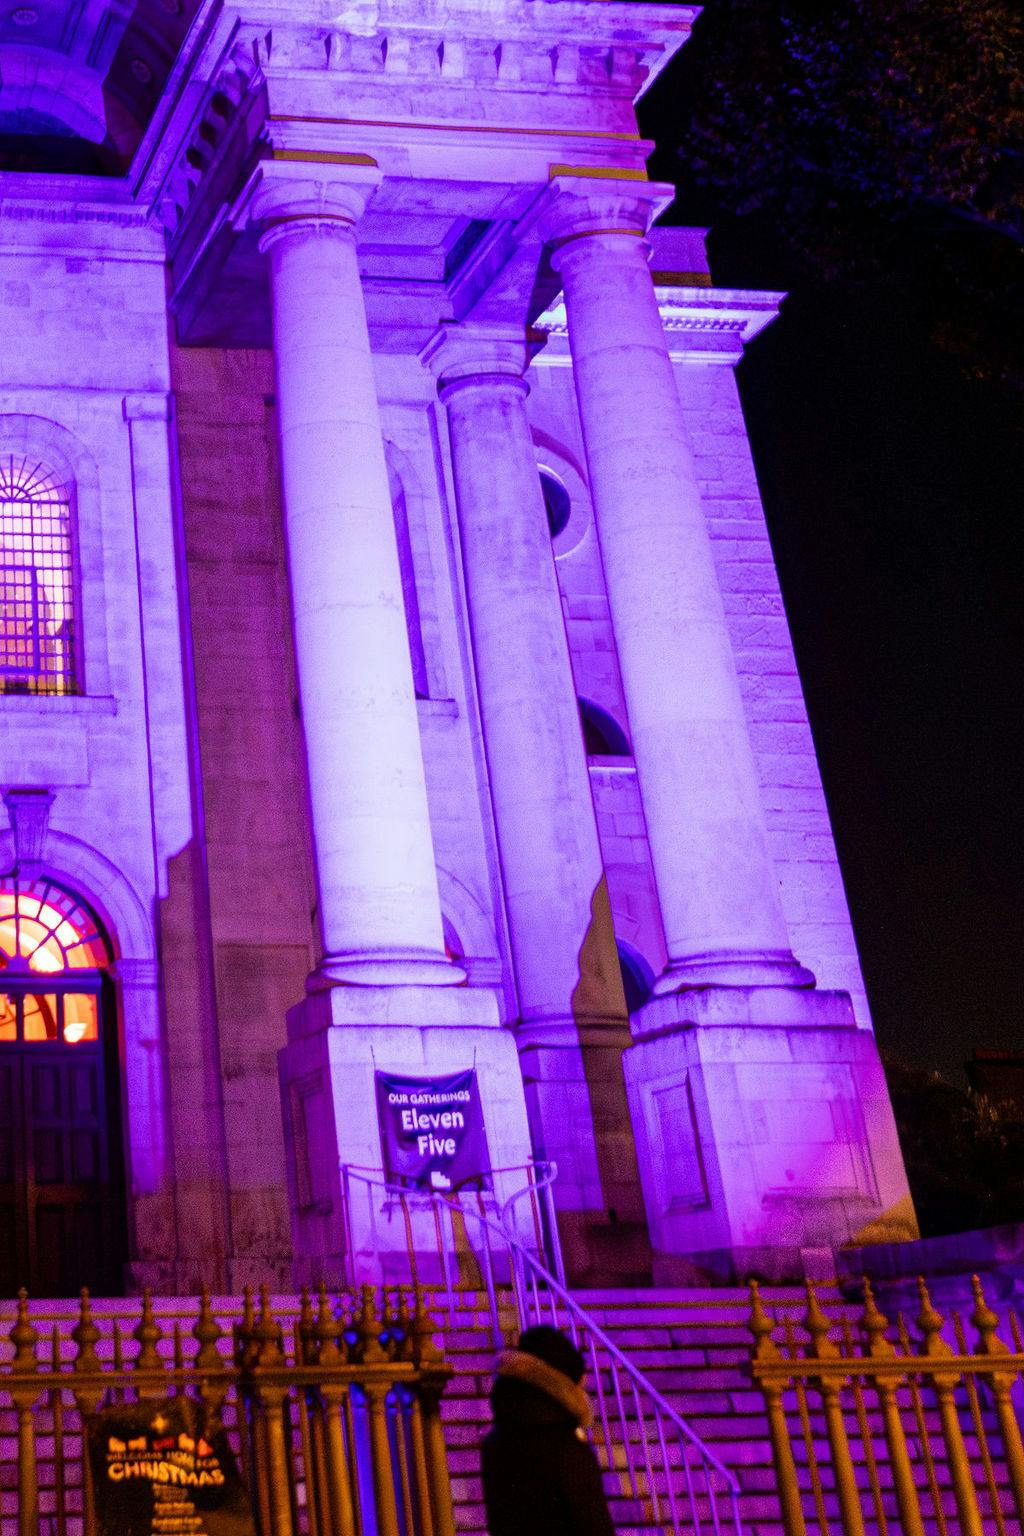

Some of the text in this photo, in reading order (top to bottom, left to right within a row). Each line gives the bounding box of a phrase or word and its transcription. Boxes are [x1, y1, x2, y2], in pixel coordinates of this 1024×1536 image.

[388, 1090, 470, 1104] OUR GATHERINGS
[401, 1108, 464, 1131] Eleven
[417, 1132, 456, 1156] Five
[108, 1460, 225, 1486] CHRISTMAS
